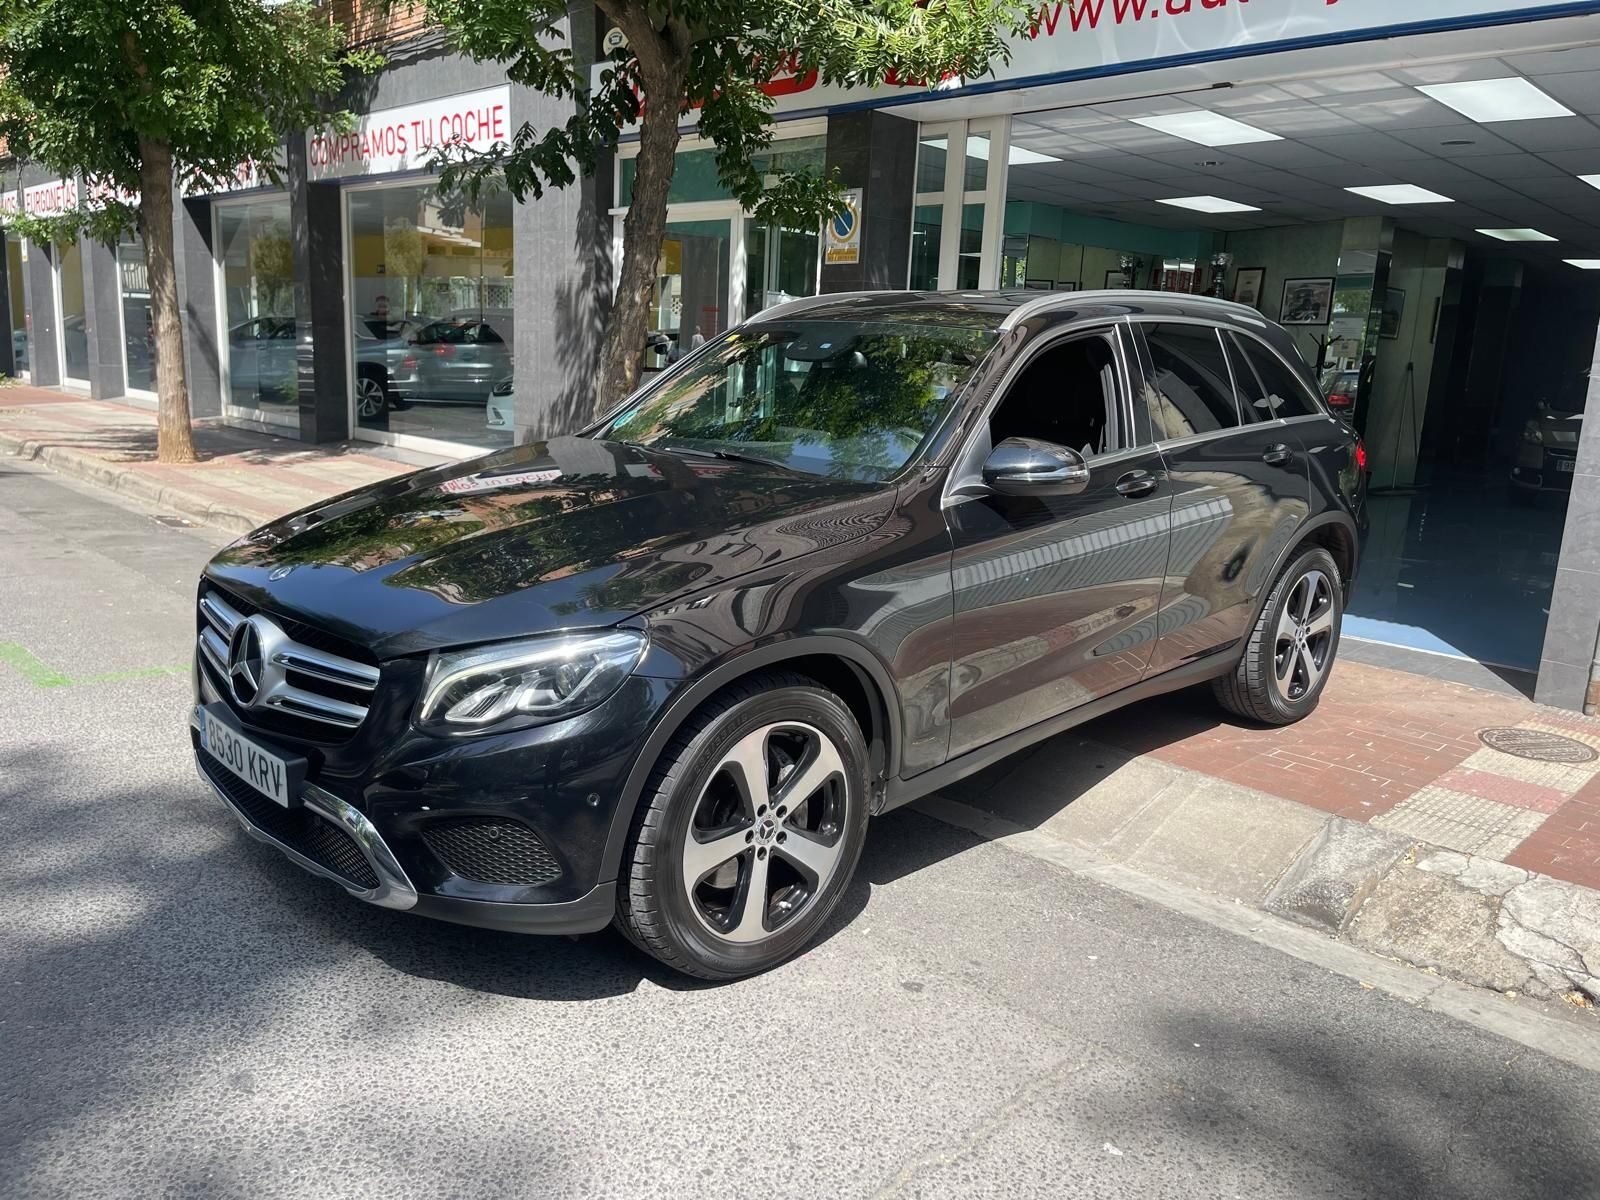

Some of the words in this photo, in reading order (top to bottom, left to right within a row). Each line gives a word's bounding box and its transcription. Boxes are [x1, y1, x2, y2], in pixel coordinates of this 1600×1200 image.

[310, 125, 407, 166] COMPRAMOS
[411, 118, 433, 151] TU
[440, 105, 504, 146] COCHE
[208, 719, 243, 773] 8530
[248, 746, 281, 798] KRV
